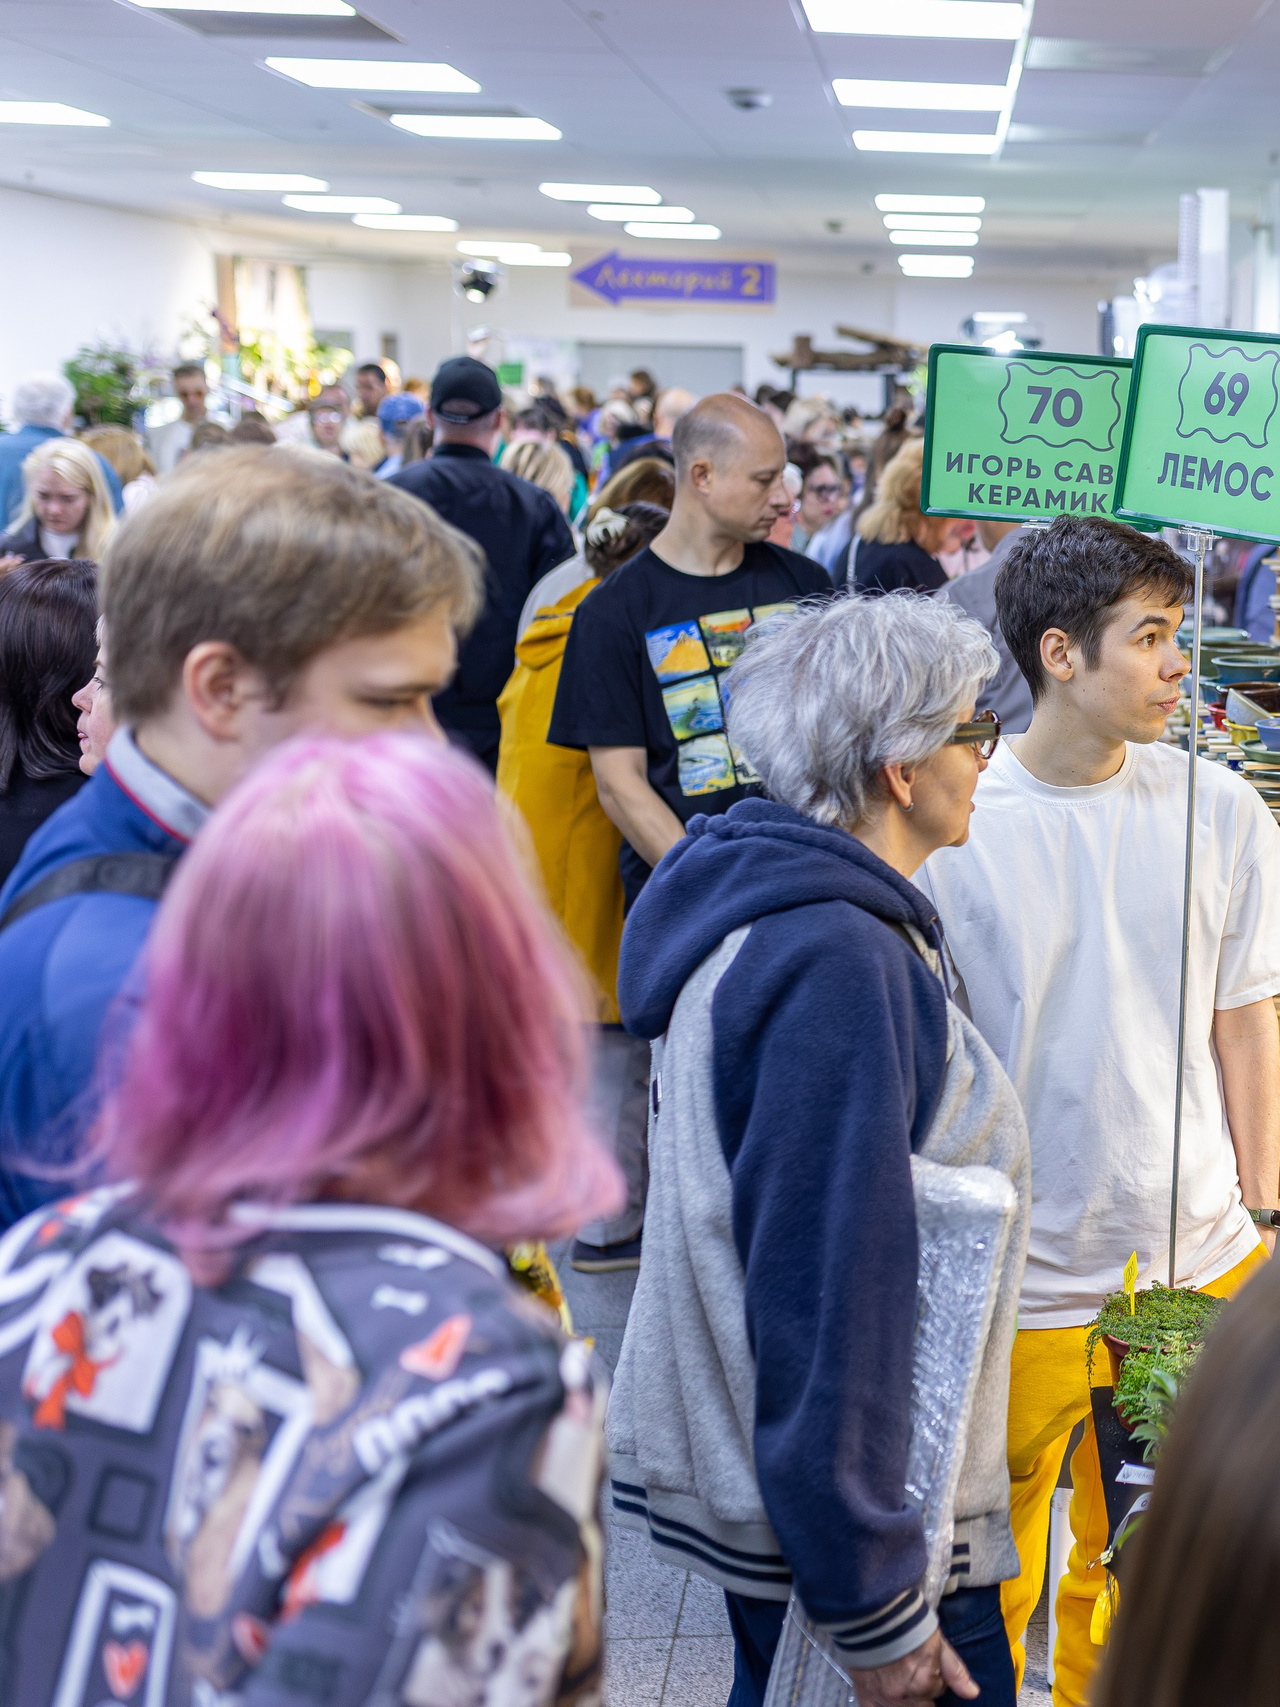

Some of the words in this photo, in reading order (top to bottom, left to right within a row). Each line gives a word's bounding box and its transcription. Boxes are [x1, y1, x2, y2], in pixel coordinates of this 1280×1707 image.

[740, 266, 761, 296] 2
[1026, 385, 1083, 428] 70
[1204, 371, 1250, 417] 69
[945, 451, 1042, 479] ИГОРЬ
[1054, 459, 1114, 485] САВ
[1157, 452, 1274, 501] ЛЕМОС
[968, 482, 1109, 513] КЕРАМИК
